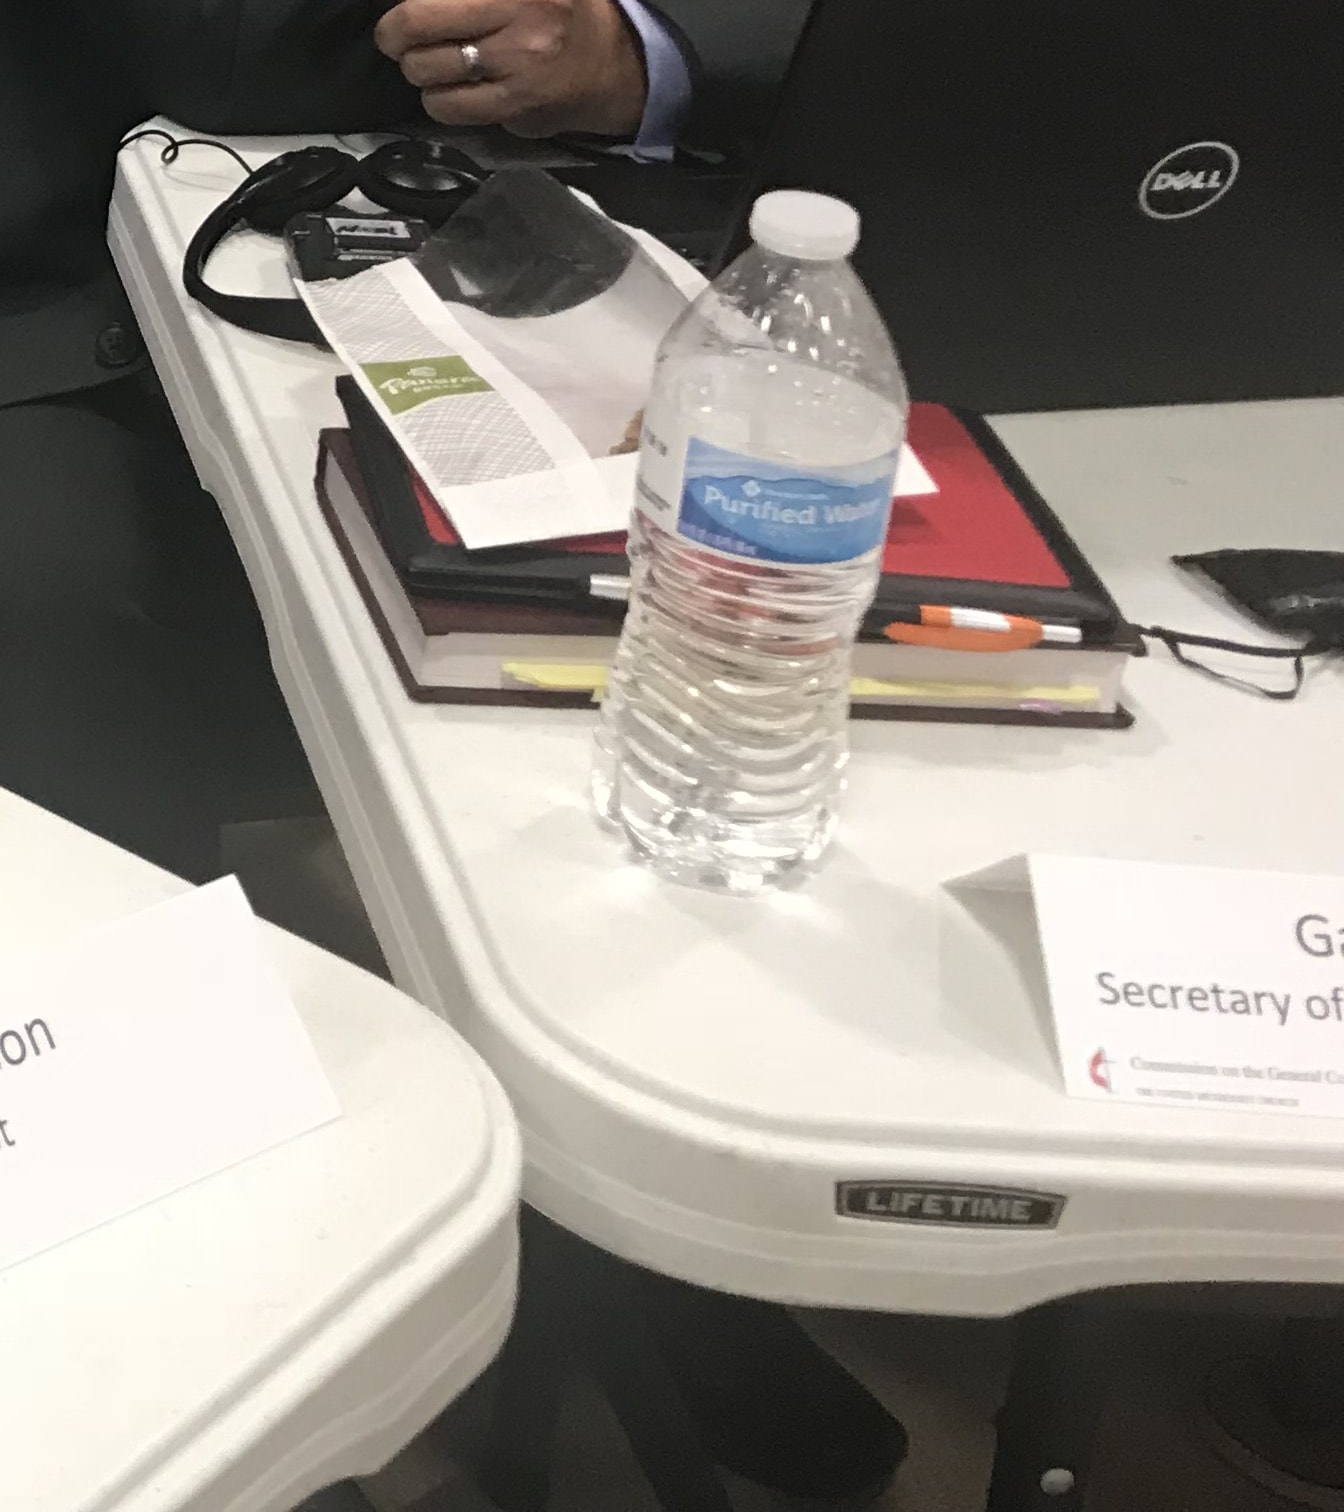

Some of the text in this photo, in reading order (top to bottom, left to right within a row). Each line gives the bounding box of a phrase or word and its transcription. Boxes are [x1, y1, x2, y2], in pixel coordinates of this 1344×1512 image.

[1150, 170, 1221, 191] DELL
[705, 485, 817, 525] Purified
[1097, 972, 1344, 1026] Secretary of
[866, 1191, 1033, 1220] LIFETIME
